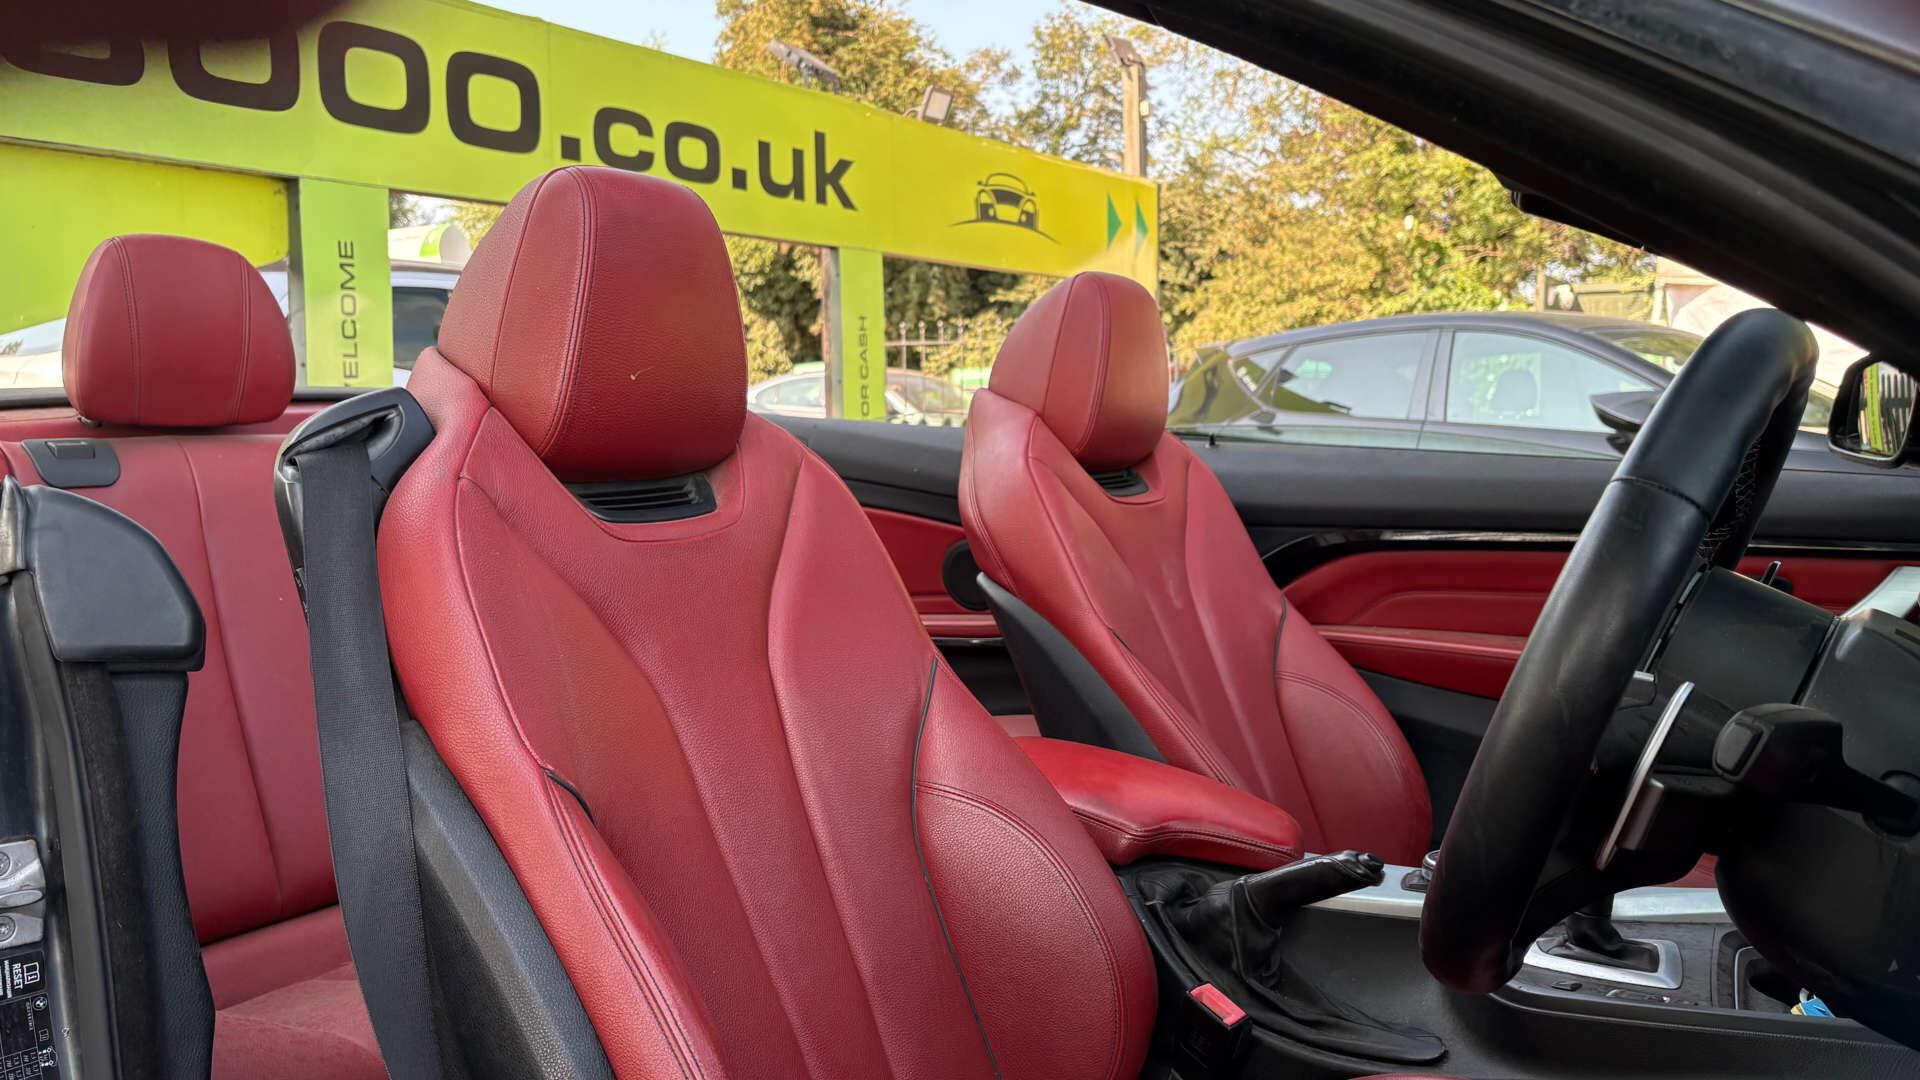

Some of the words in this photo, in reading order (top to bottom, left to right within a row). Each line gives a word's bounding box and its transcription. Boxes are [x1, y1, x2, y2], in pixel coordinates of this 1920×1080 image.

[337, 239, 360, 387] ELCOME
[857, 315, 869, 380] CASH
[860, 384, 870, 417] OR
[12, 962, 23, 990] RESET
